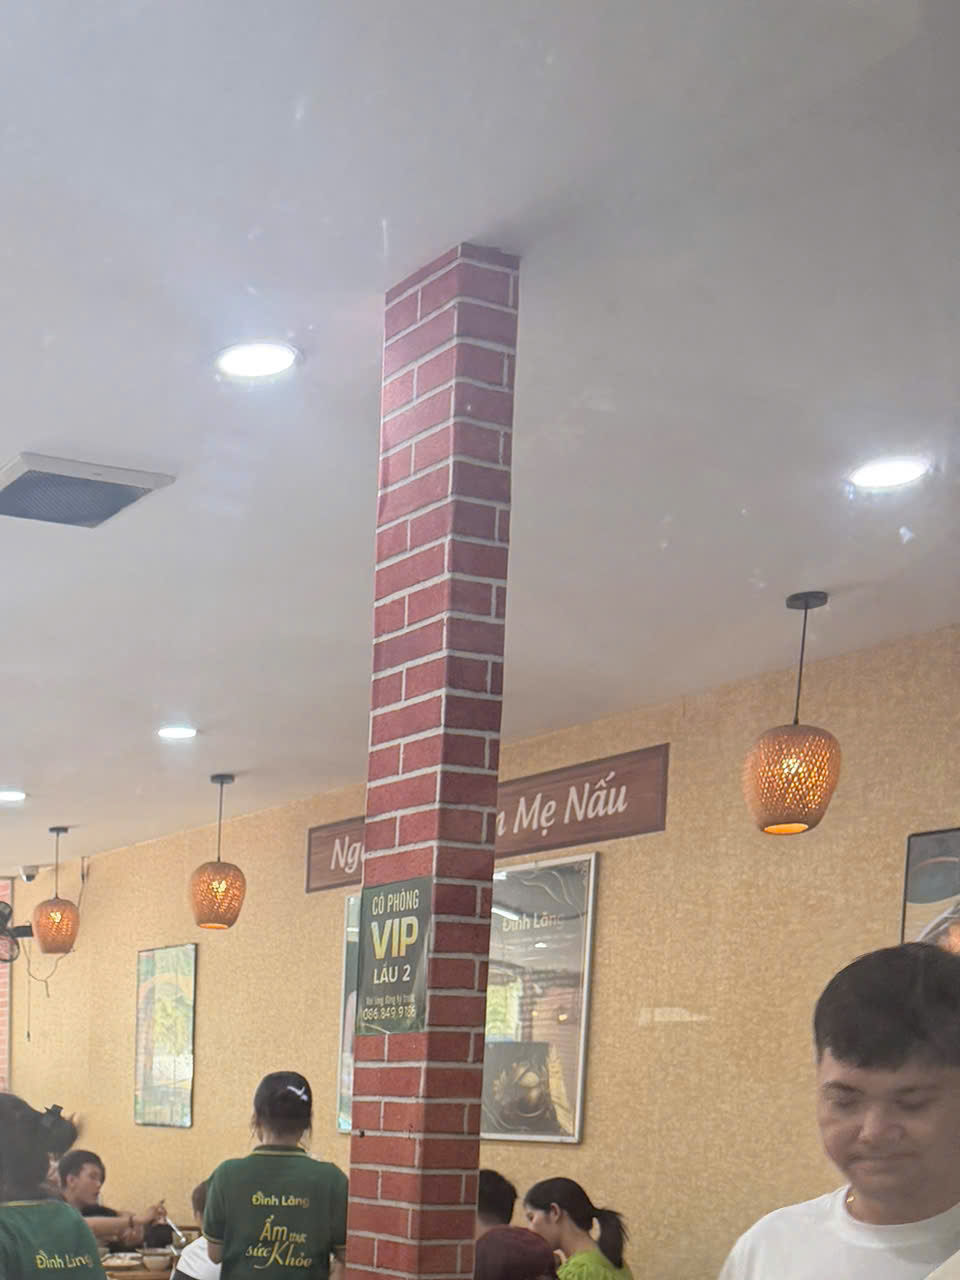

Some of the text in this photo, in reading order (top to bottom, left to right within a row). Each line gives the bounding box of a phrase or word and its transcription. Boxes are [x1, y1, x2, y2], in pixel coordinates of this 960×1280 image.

[513, 792, 556, 837] Mẹ
[563, 771, 628, 825] Nấu
[371, 915, 419, 960] VIP
[402, 964, 411, 982] 2
[259, 1214, 288, 1241] Ẩm
